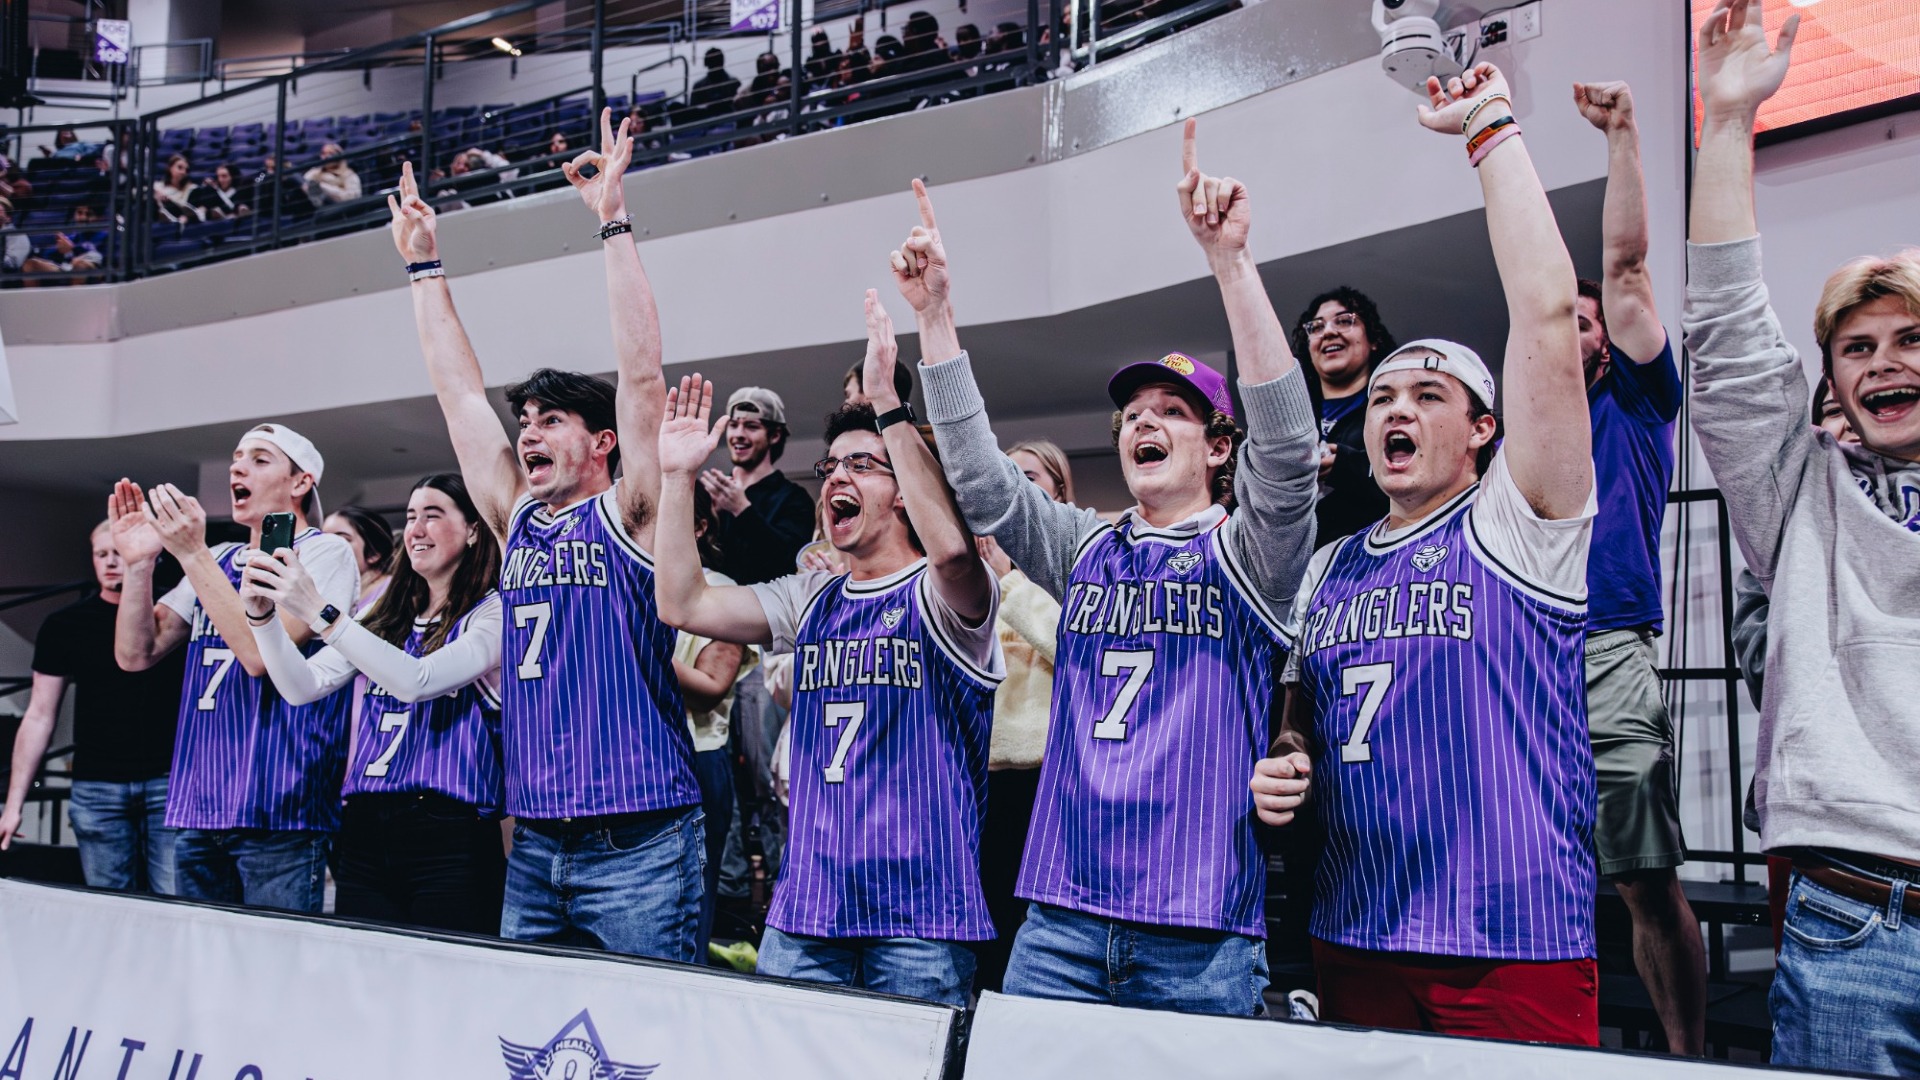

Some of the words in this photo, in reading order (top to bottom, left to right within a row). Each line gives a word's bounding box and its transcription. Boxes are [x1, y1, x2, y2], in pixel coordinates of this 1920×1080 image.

[513, 601, 552, 681] 7
[1303, 579, 1474, 658] RANGLERS
[198, 647, 236, 711] 7
[797, 636, 923, 691] RNGLERS
[1092, 648, 1156, 741] 7
[363, 709, 411, 777] 7
[823, 701, 866, 785] 7
[1340, 661, 1395, 763] 7
[554, 1038, 599, 1058] HEALTH
